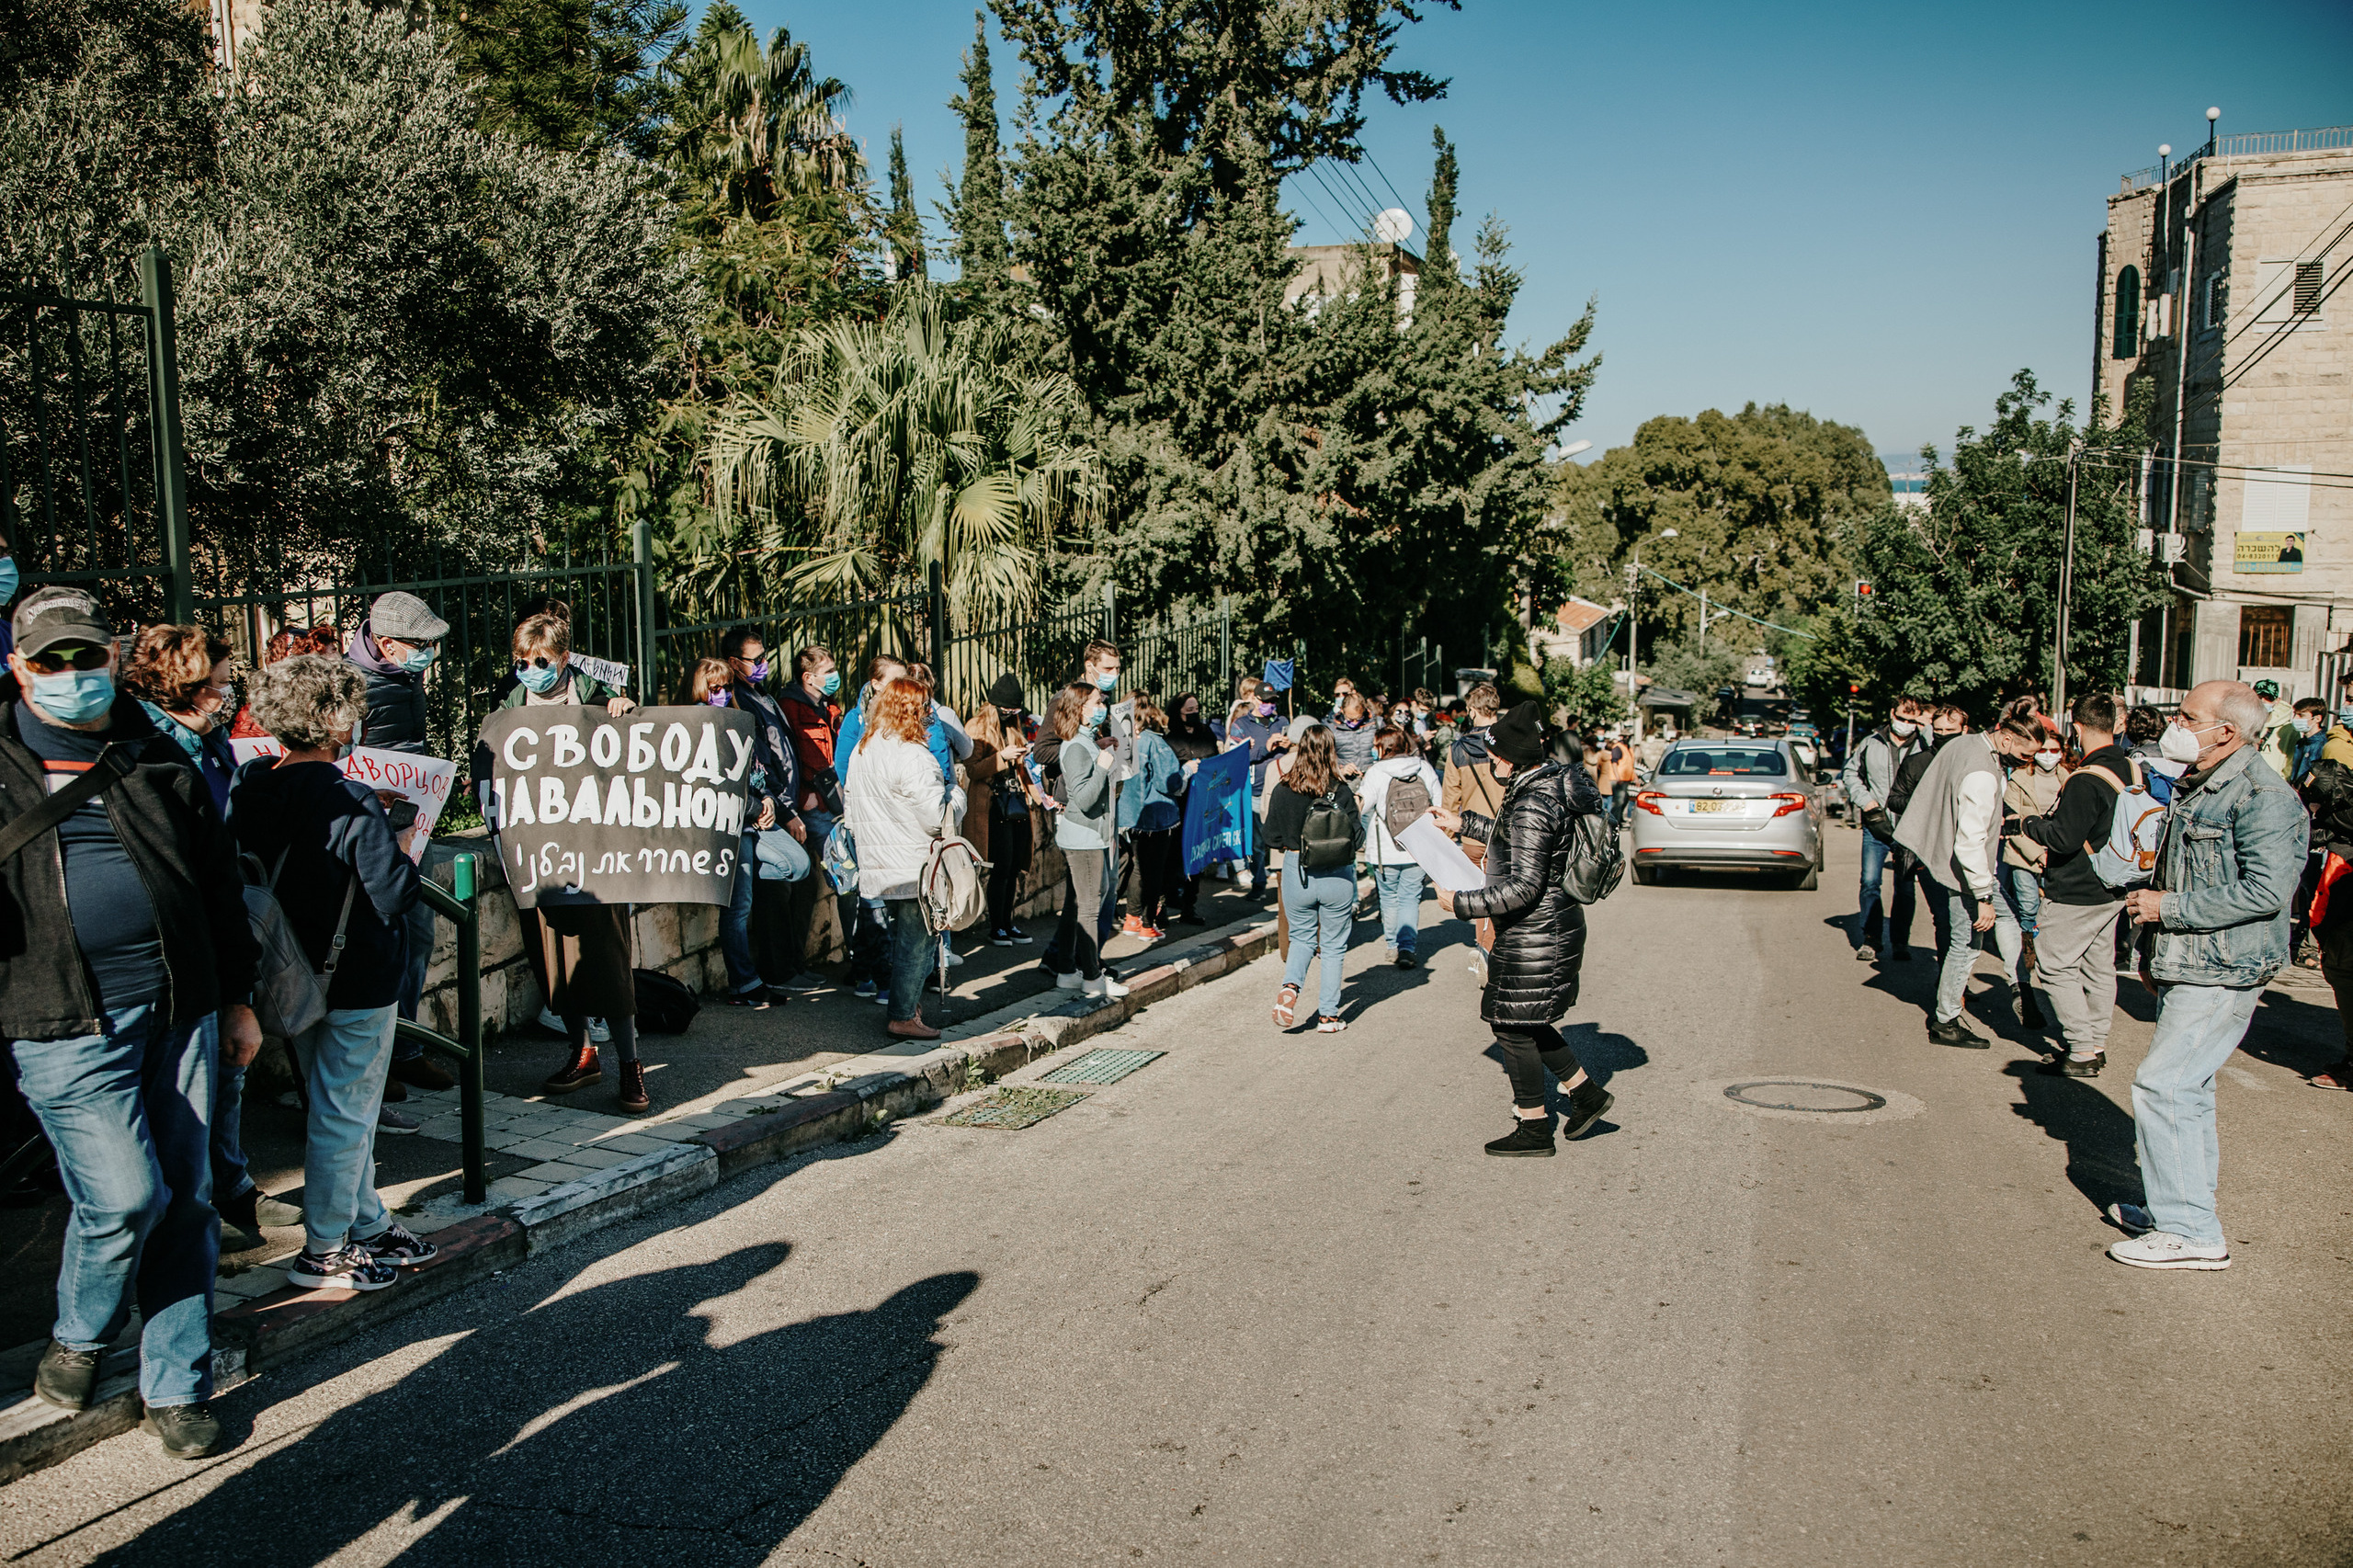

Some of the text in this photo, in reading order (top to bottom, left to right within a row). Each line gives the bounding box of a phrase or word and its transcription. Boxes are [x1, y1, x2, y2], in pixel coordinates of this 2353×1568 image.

[504, 722, 754, 785] СВОБОДУ
[343, 755, 450, 801] ДВОРЦОВ
[592, 851, 632, 874] את
